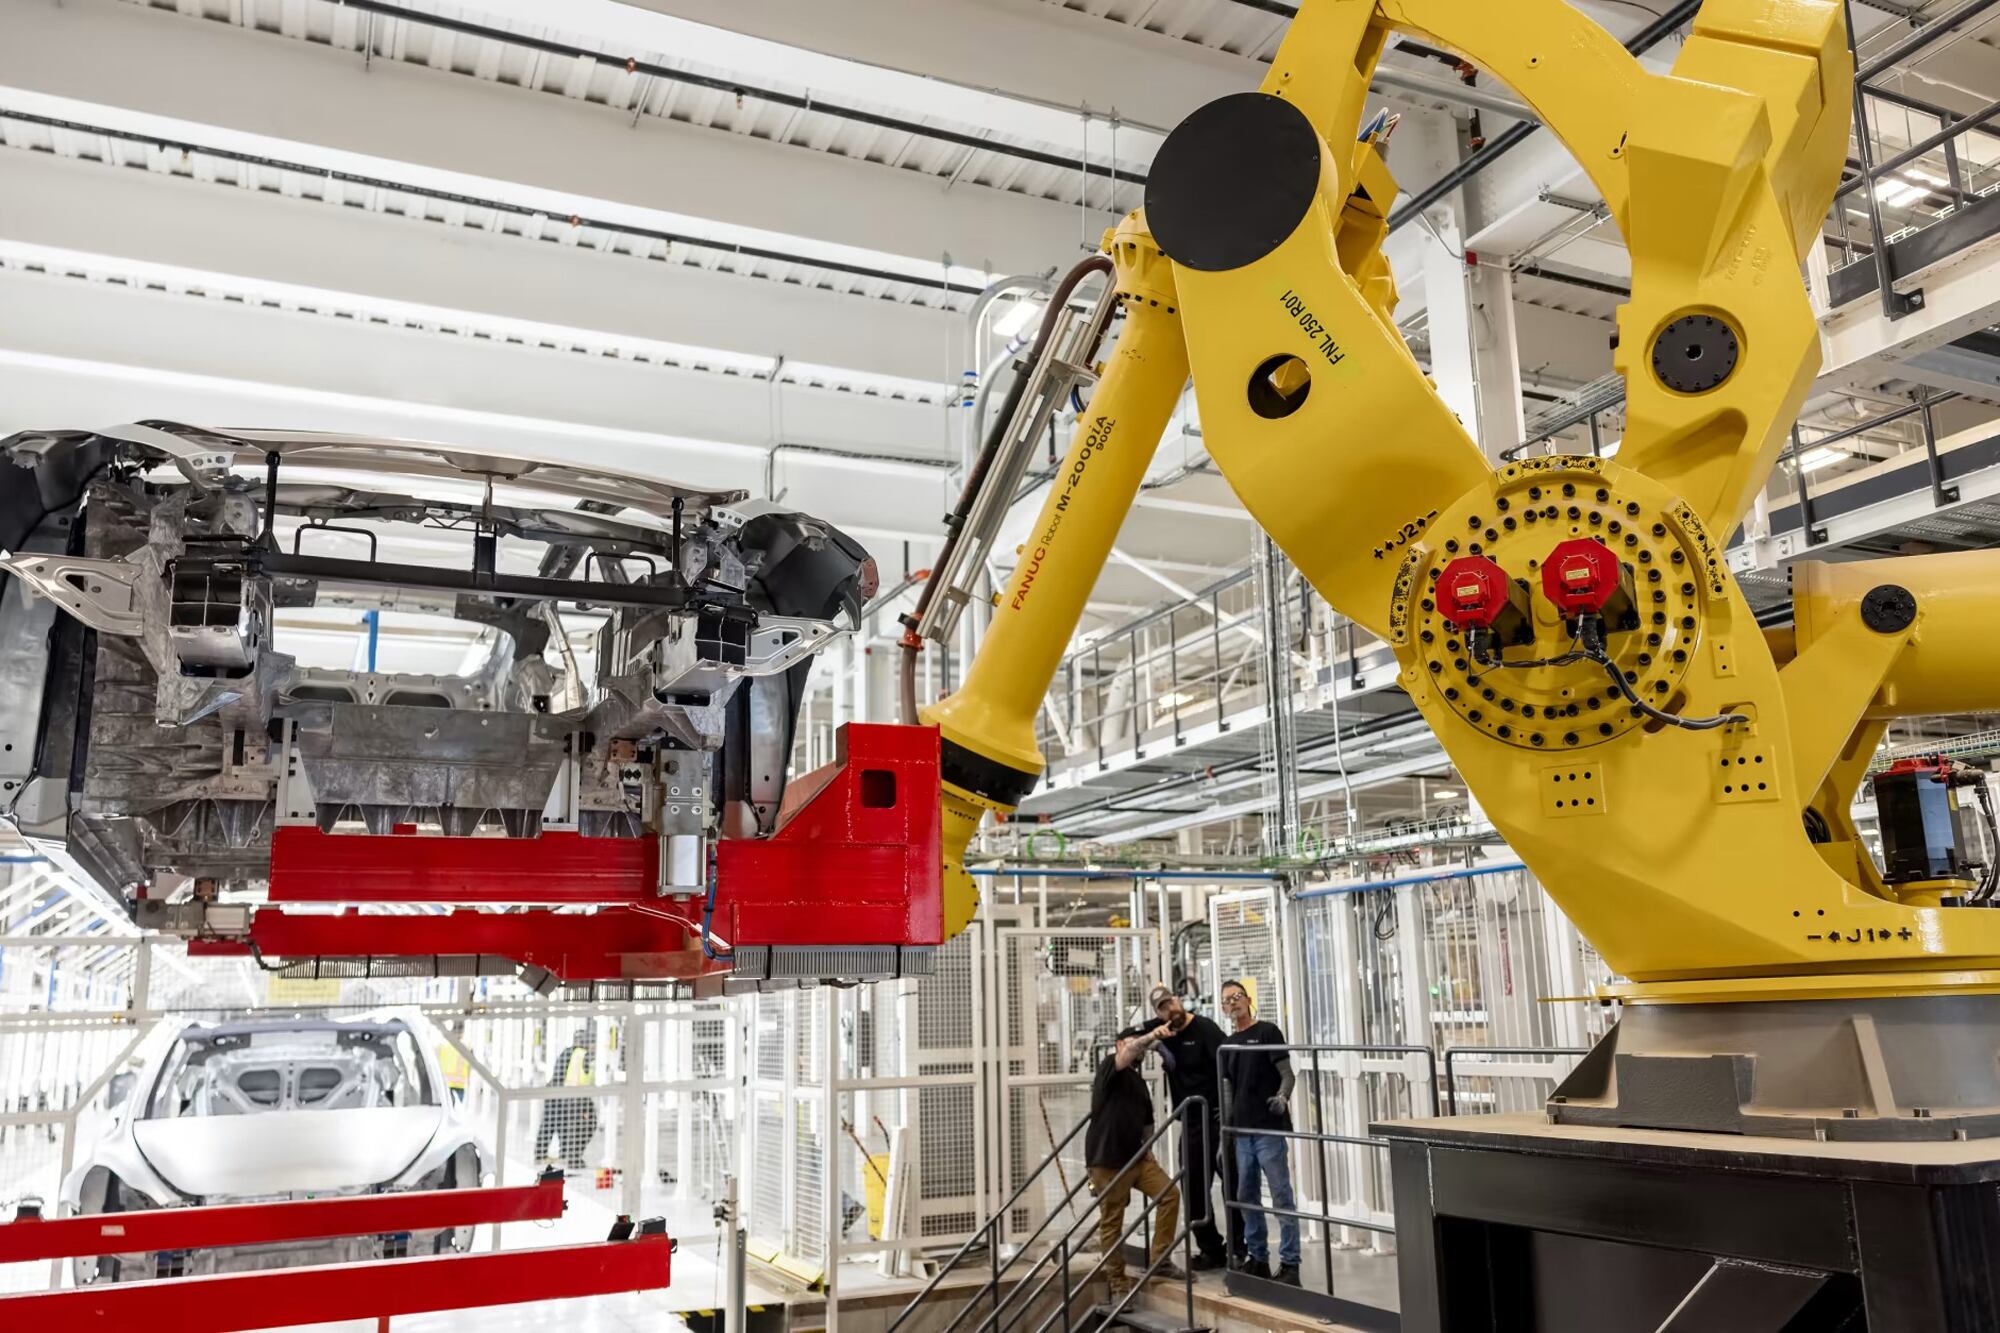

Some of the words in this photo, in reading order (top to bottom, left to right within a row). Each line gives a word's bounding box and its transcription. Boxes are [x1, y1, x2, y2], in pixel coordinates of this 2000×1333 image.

[1280, 289, 1306, 318] R01
[1299, 313, 1325, 339] 250
[1319, 333, 1345, 365] FNL
[1095, 419, 1116, 451] 900L
[1012, 545, 1045, 610] FANUC
[1040, 514, 1062, 546] Robot
[1056, 416, 1108, 511] M-2000iA
